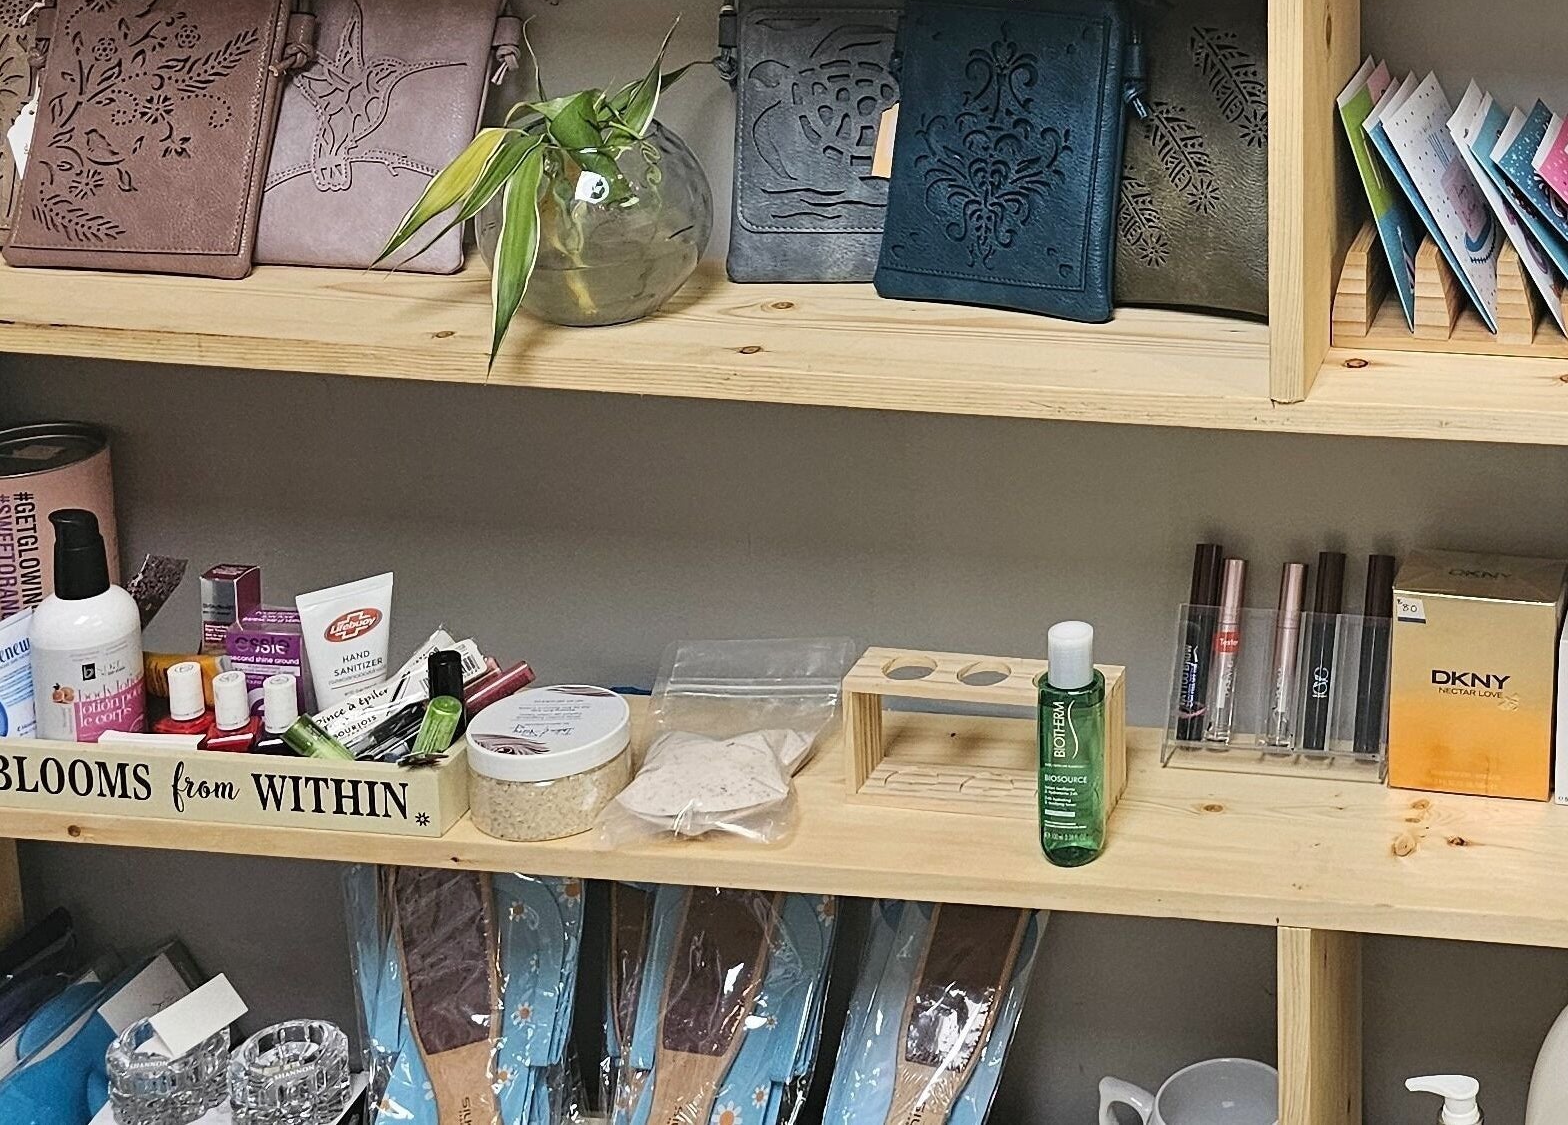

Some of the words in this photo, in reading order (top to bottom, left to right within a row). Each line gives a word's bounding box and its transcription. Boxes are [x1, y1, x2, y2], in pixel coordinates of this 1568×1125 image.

[0, 494, 20, 619] #SWEETORAN
[14, 492, 43, 609] #GETGLOWIN
[330, 617, 375, 635] Lifebuoy
[342, 650, 370, 663] HAND
[334, 657, 383, 676] SANITIZER
[1431, 670, 1511, 689] DKNY
[1438, 687, 1476, 696] NECTAR
[1480, 690, 1504, 698] LOVE
[1053, 701, 1066, 758] BIOTHERM
[0, 755, 152, 801] BLOOMS
[172, 761, 240, 813] from
[251, 773, 408, 819] WITHIN
[1044, 774, 1088, 784] BIOSOURCE
[129, 1060, 168, 1069] SHANNON
[274, 1065, 315, 1080] SHANNON
